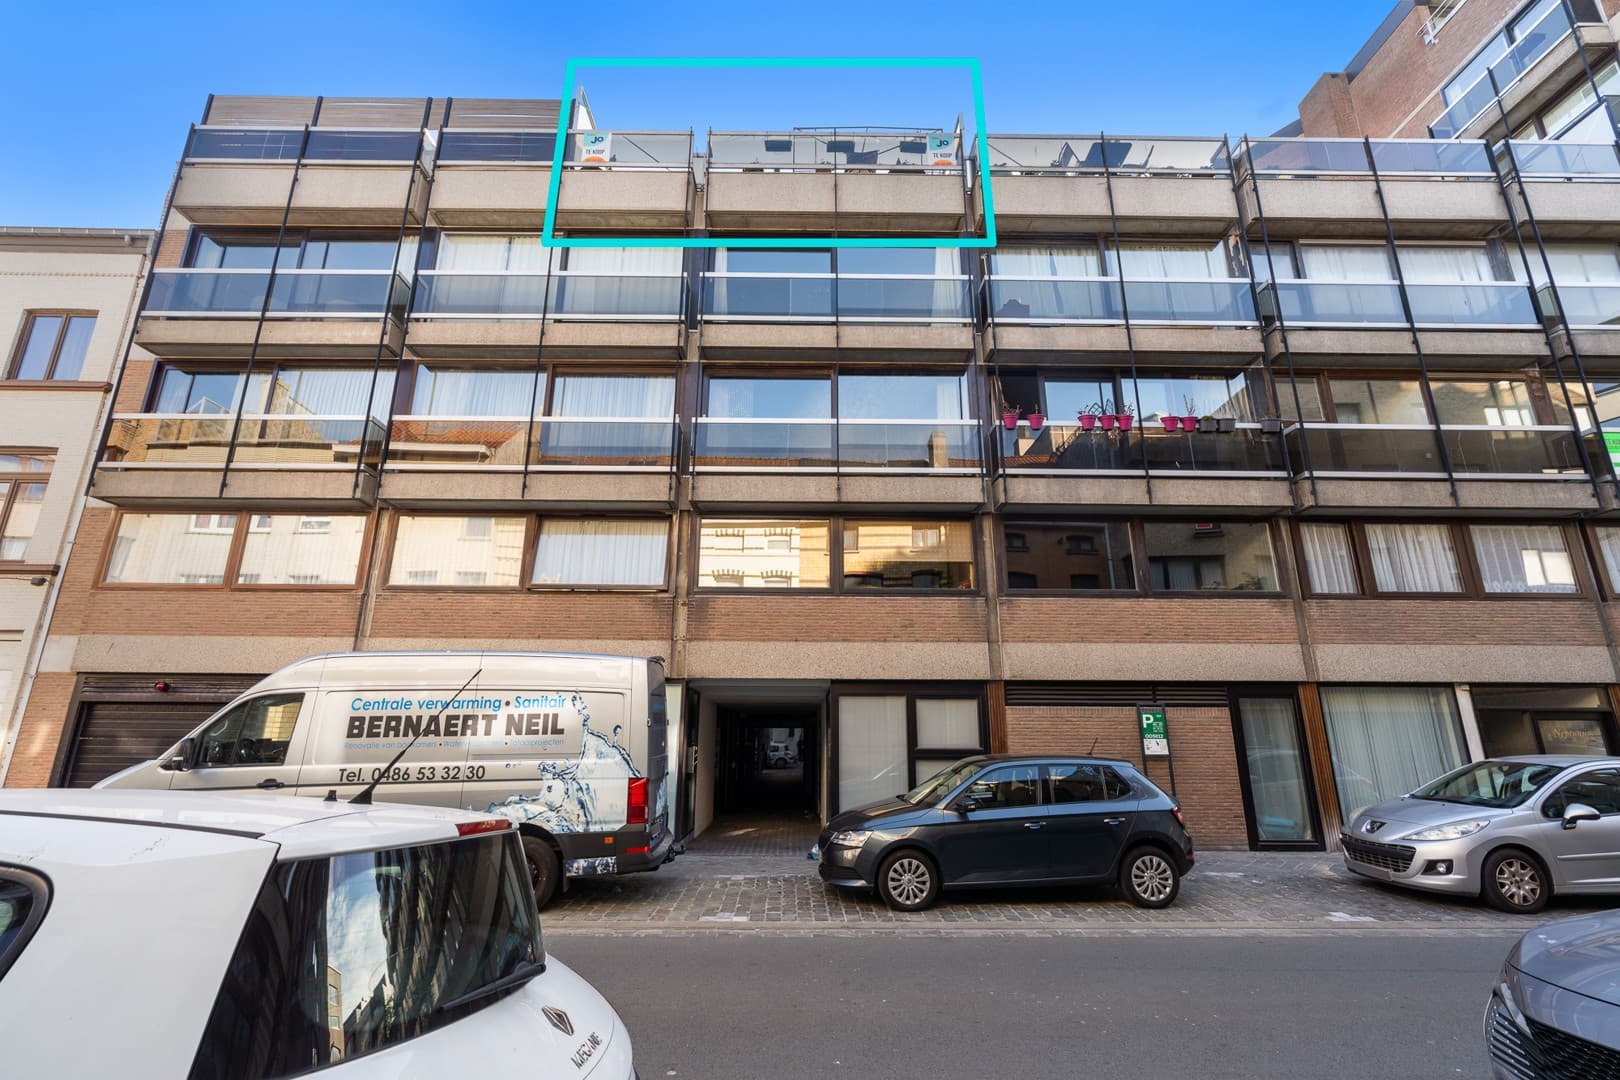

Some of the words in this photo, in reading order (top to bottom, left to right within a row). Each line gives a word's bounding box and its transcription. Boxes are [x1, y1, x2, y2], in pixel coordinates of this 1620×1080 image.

[351, 697, 413, 712] Centrale
[417, 696, 502, 713] verwarming
[514, 695, 566, 709] Sanitair
[346, 715, 498, 738] BERNAERT
[505, 712, 565, 736] NEIL
[1142, 714, 1154, 728] P
[339, 768, 365, 782] Tel.
[371, 767, 411, 781] 0486
[416, 766, 436, 780] 53
[441, 766, 461, 780] 32
[465, 765, 486, 780] 30
